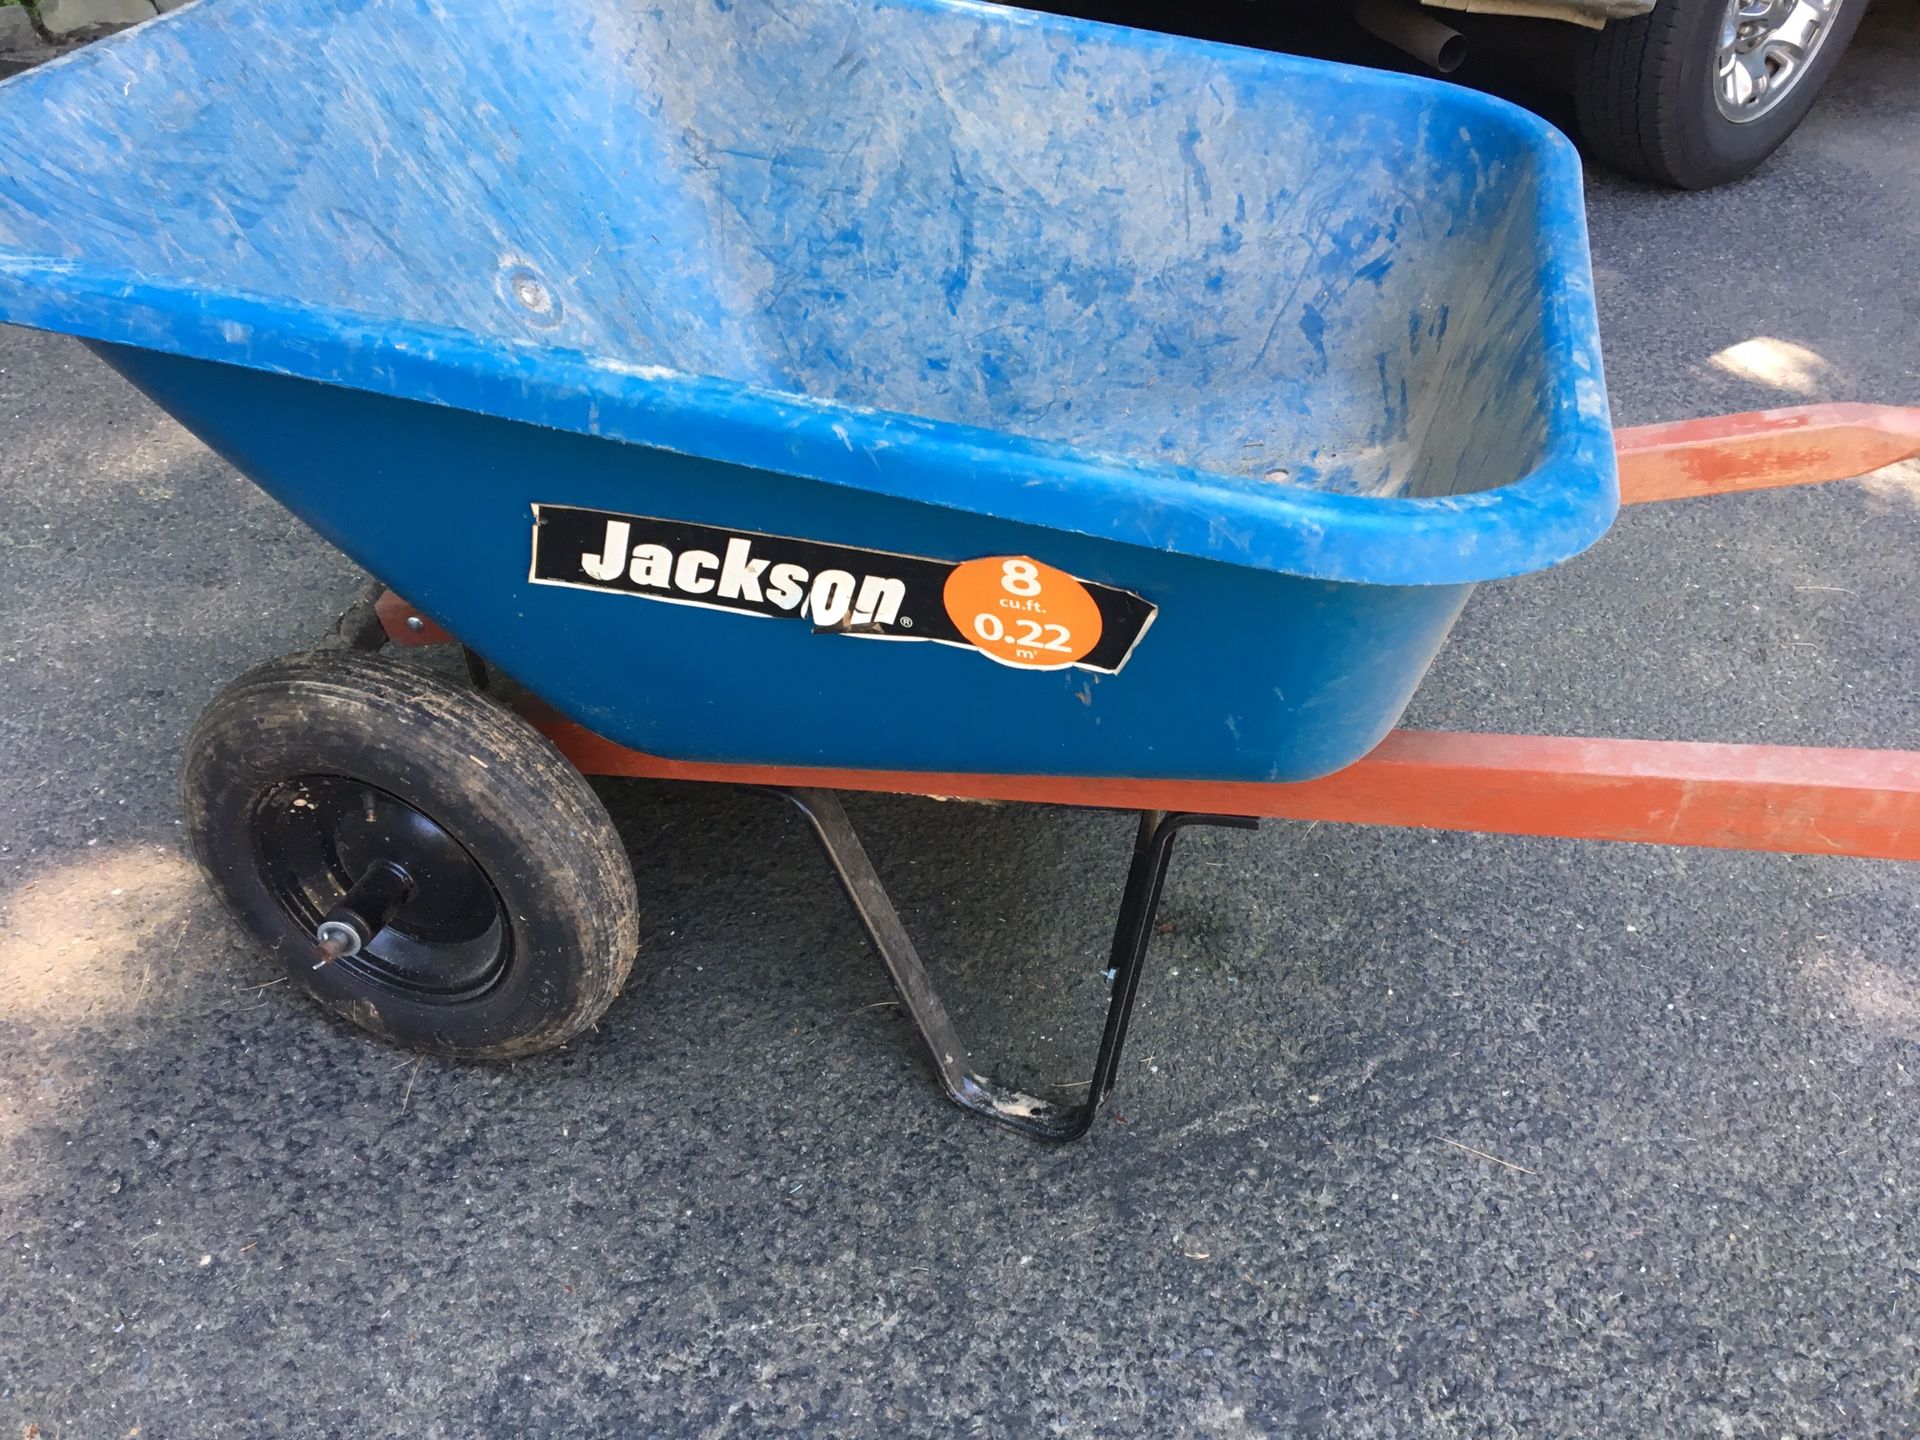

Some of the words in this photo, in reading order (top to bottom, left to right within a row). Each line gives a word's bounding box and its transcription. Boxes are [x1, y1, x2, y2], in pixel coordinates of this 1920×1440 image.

[581, 520, 906, 627] Jackson
[1001, 559, 1042, 597] 8
[999, 597, 1047, 614] cu.ft.
[973, 613, 1072, 653] 0.22
